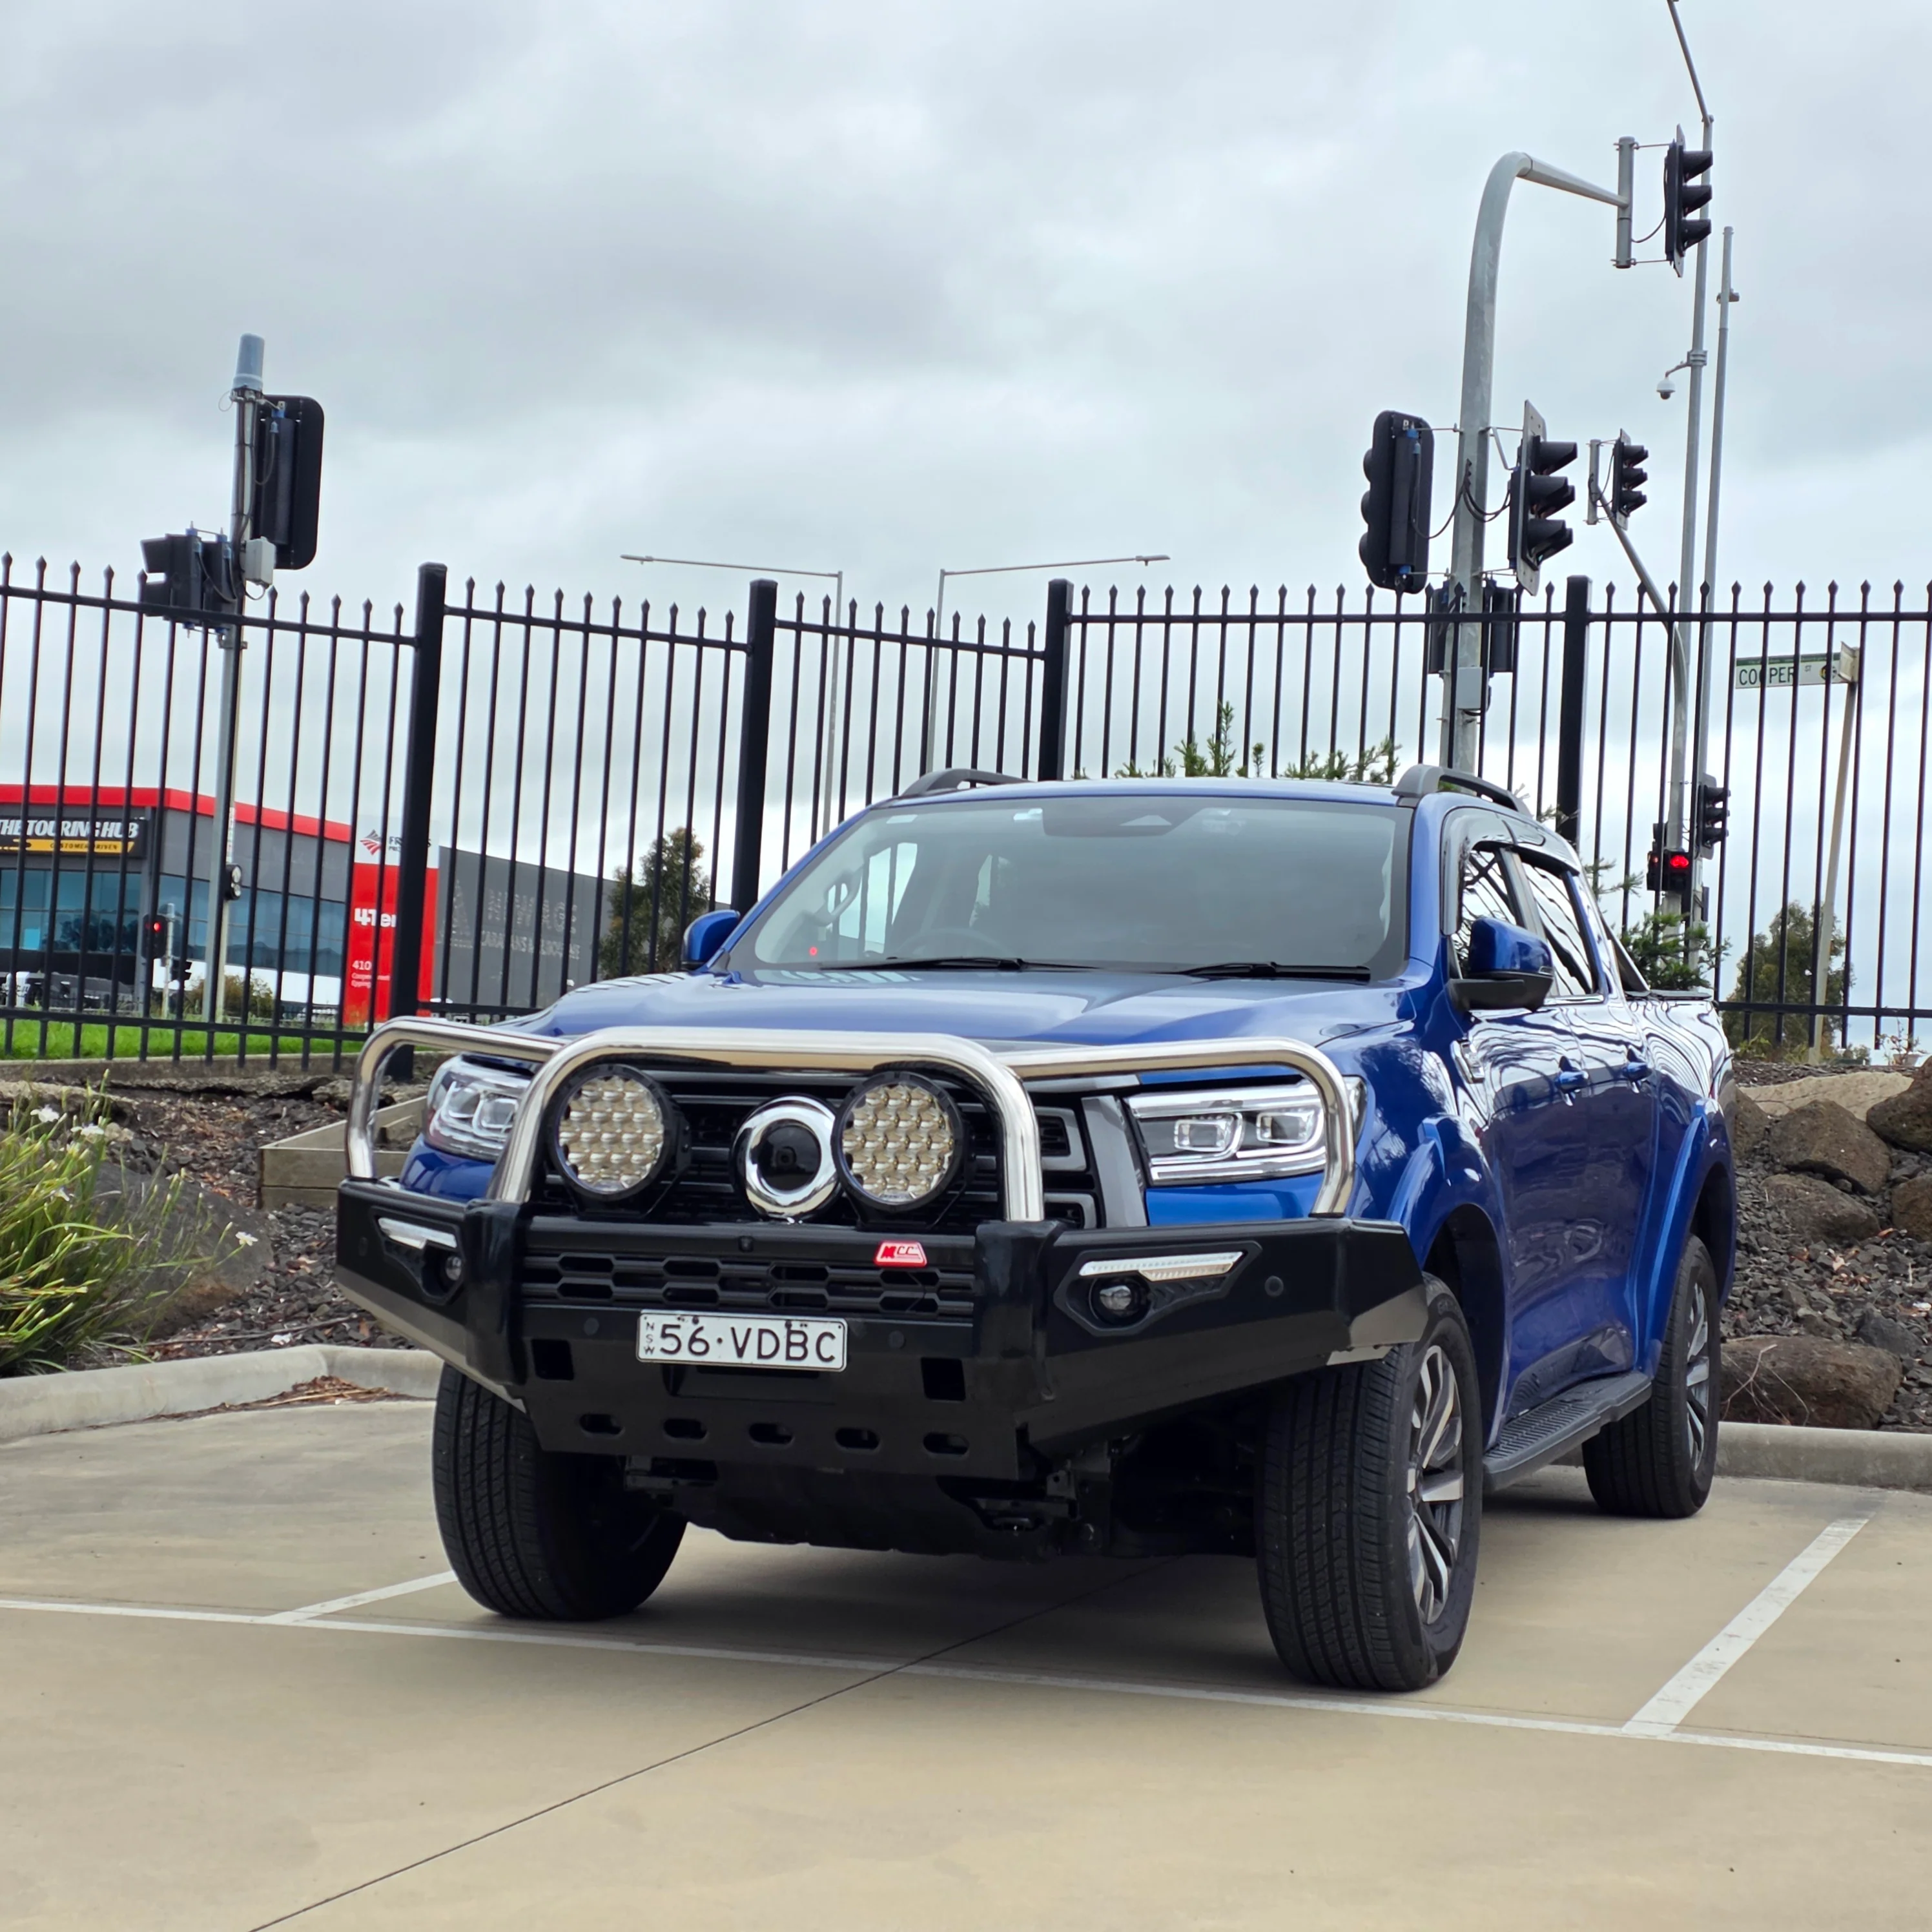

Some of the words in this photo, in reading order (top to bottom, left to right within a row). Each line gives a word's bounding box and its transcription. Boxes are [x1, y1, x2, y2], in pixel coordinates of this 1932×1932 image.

[1739, 666, 1794, 685] COPER
[0, 819, 21, 836] THE
[101, 821, 139, 838] HUB
[352, 960, 372, 971] 410
